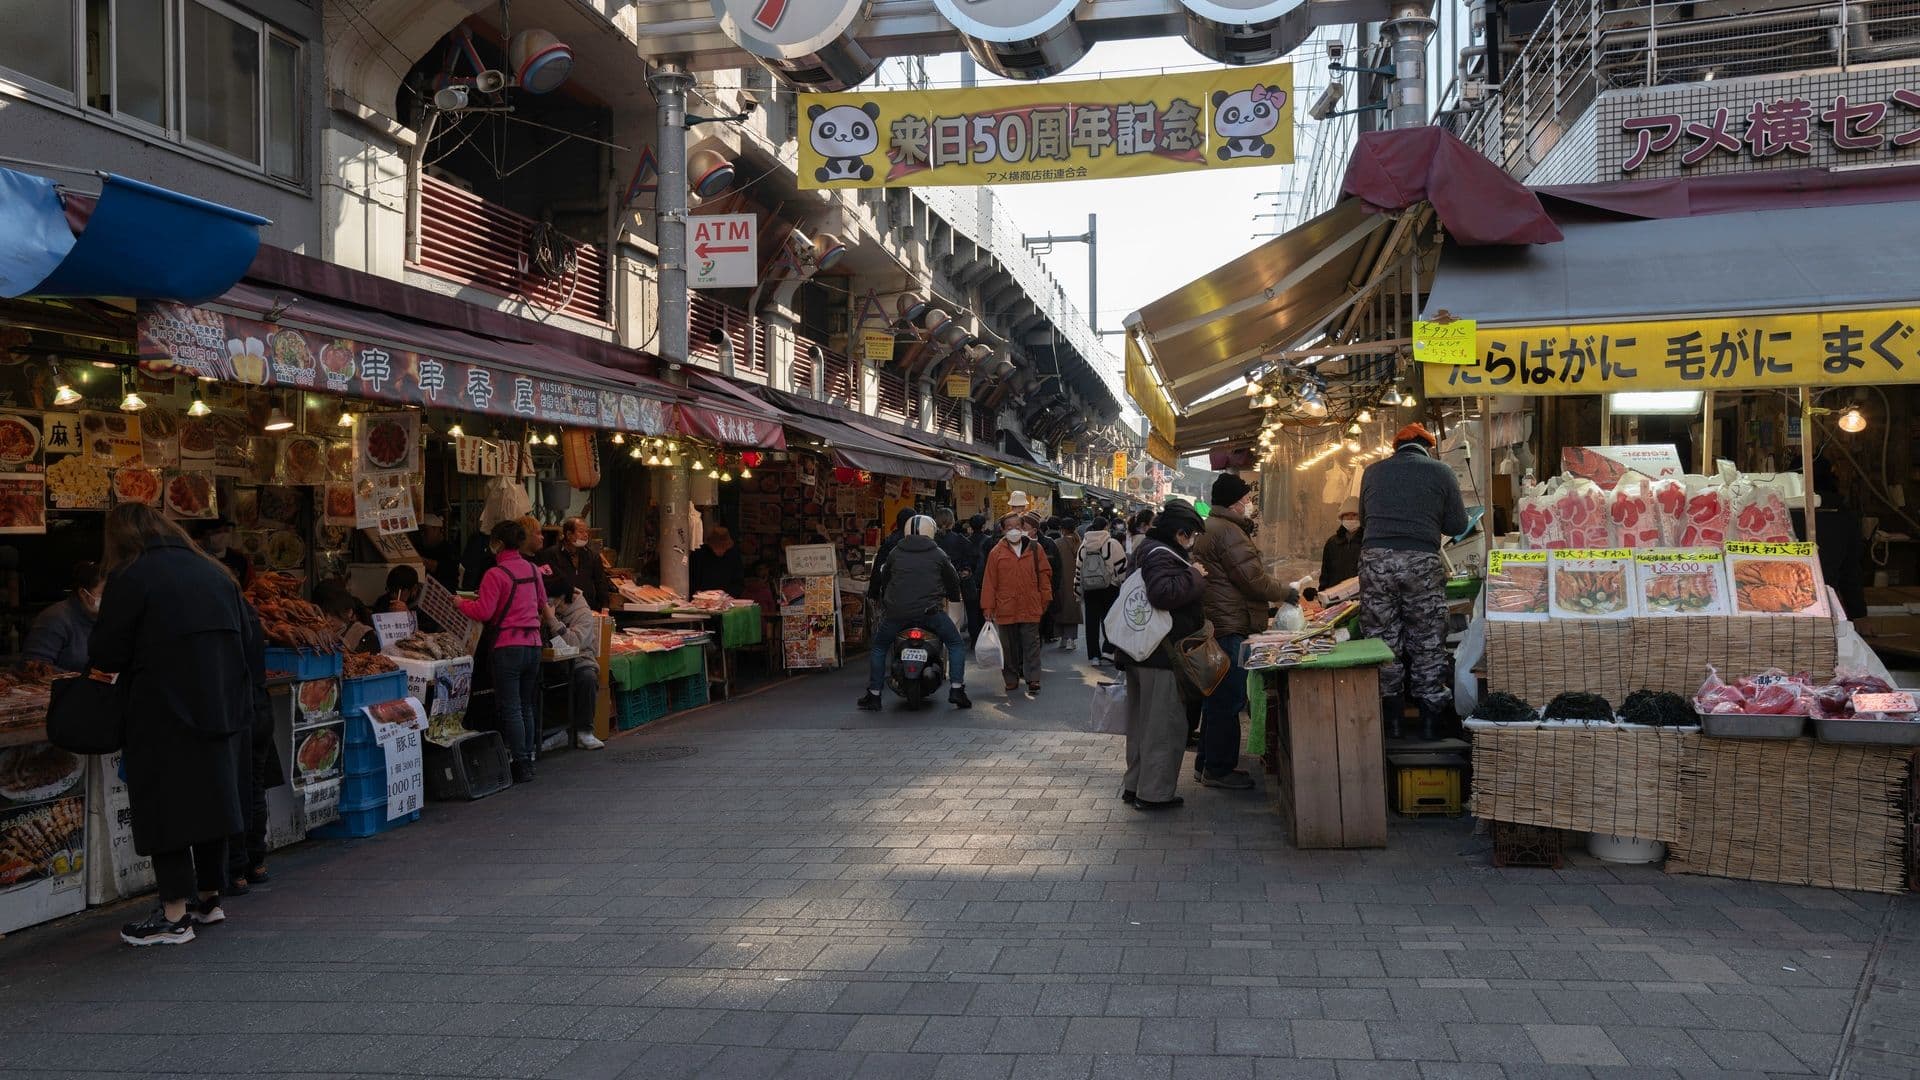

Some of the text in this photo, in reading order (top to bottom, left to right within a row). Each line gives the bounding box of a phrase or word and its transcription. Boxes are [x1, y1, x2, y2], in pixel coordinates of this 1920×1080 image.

[891, 98, 1202, 165] 来日50周年記念
[987, 166, 1087, 183] アメ横商店街連合会
[695, 221, 750, 241] ATM
[1665, 329, 1793, 381] 毛がに
[1822, 320, 1920, 374] まぐ
[396, 732, 417, 753] 豚足
